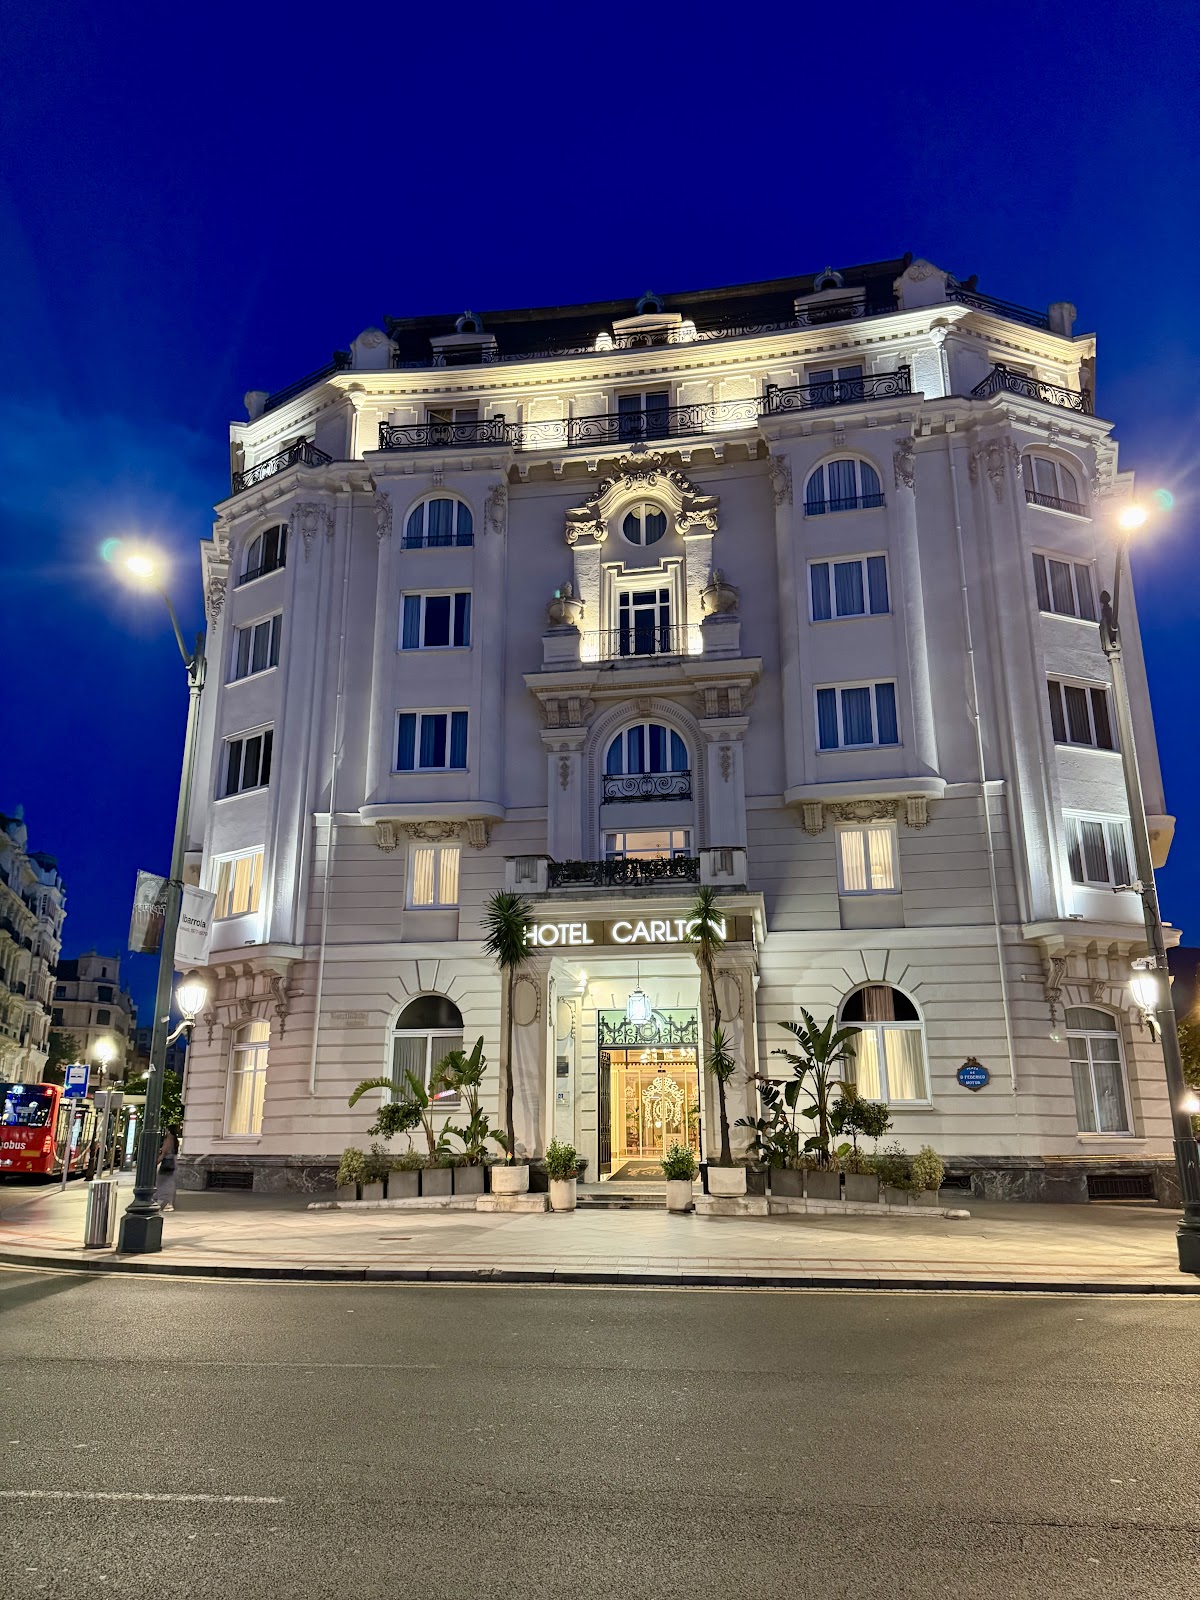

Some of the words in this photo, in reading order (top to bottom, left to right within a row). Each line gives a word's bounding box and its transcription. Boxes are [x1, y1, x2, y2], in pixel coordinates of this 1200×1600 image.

[182, 914, 206, 928] Ibarrola
[522, 922, 594, 946] HOTEL
[612, 918, 727, 943] CARLTON
[0, 1140, 26, 1150] obus
